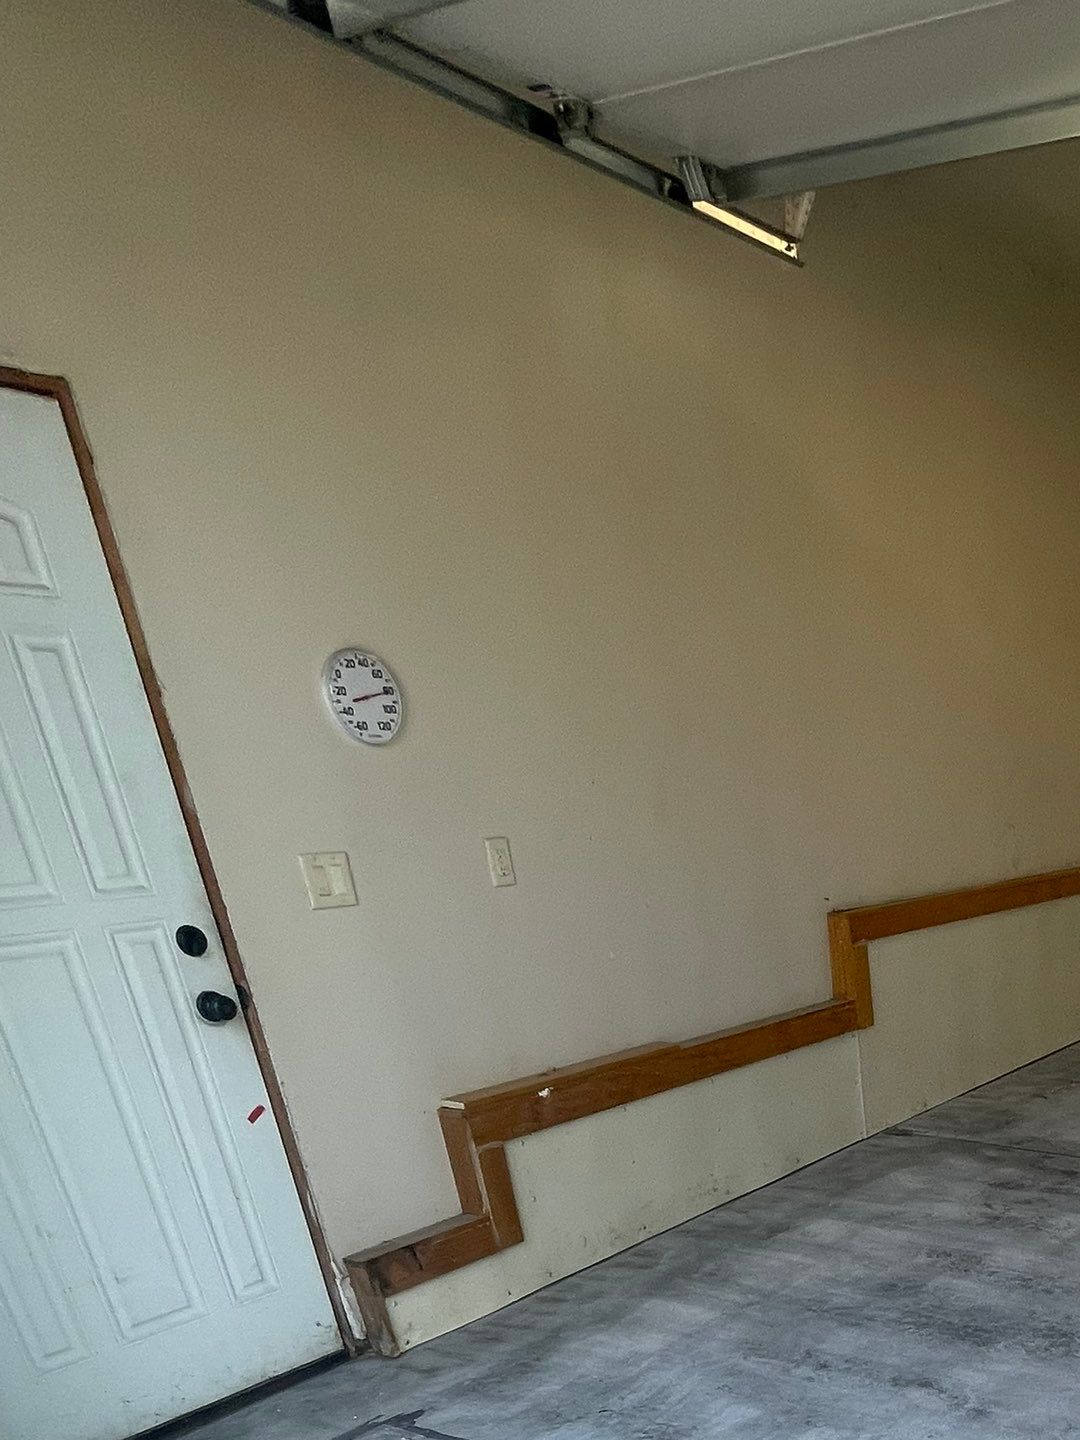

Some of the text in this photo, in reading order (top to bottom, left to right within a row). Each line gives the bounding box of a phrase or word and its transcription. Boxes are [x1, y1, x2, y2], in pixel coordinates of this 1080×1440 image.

[344, 659, 356, 669] 20
[357, 658, 369, 668] 40
[334, 669, 342, 679] 0
[371, 669, 383, 679] 60
[382, 705, 397, 714] 100
[377, 721, 392, 731] 120
